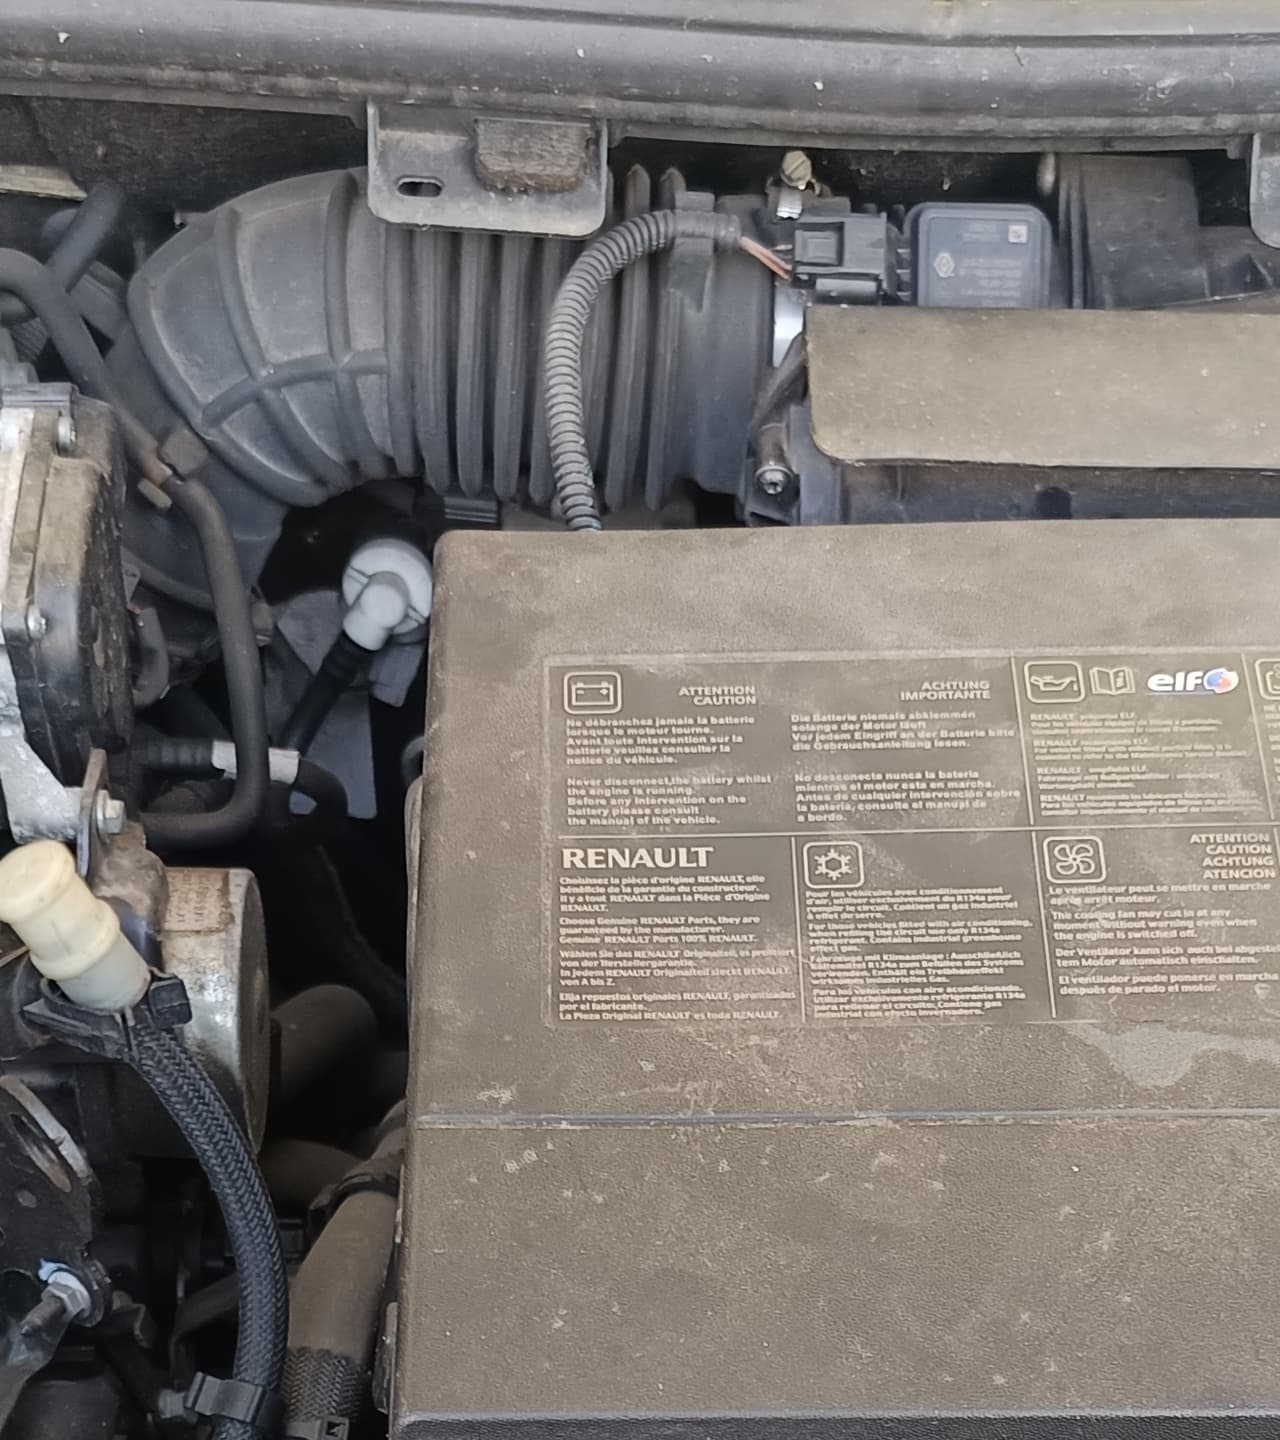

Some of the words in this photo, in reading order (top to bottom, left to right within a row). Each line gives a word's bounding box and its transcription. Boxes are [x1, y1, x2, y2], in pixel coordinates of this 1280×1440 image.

[921, 680, 990, 690] ACHTUNG
[1147, 671, 1204, 692] elf
[678, 685, 756, 696] ATTENTION
[900, 690, 992, 700] IMPORTANTE
[693, 696, 756, 706] CAUTION
[584, 718, 653, 726] débranchez
[655, 717, 695, 727] jamais
[710, 716, 755, 724] batterie
[566, 727, 611, 737] lorsque
[626, 726, 669, 735] moteur
[671, 726, 715, 734] tourne.
[792, 722, 838, 732] solange
[840, 722, 860, 730] der
[862, 722, 897, 730] Motor
[566, 737, 601, 745] Avant
[603, 737, 634, 745] toute
[636, 736, 707, 744] intervention
[792, 733, 813, 741] Vor
[815, 732, 851, 742] jedem
[853, 731, 897, 741] Eingriff
[917, 730, 938, 738] der
[939, 729, 986, 738] Batterie
[987, 729, 1014, 737] bitte
[792, 742, 811, 750] die
[813, 741, 932, 750] Gebrauchsanleitung
[933, 739, 969, 747] lesen.
[566, 747, 611, 755] batterie
[613, 746, 659, 754] veuillez
[661, 745, 717, 753] consulter
[566, 756, 603, 764] notice
[623, 755, 677, 763] véhicule.
[567, 777, 602, 785] Never
[672, 776, 690, 784] the
[691, 776, 733, 786] battery
[735, 775, 771, 784] whilst
[567, 787, 586, 795] the
[588, 786, 630, 796] engine
[568, 797, 607, 805] Before
[634, 796, 706, 804] intervention
[726, 796, 746, 804] the
[568, 807, 609, 816] battery
[611, 806, 651, 816] please
[653, 806, 699, 814] consult
[568, 817, 587, 825] the
[589, 816, 634, 825] manual
[651, 816, 671, 824] the
[672, 816, 720, 824] vehicle.
[1190, 833, 1270, 844] ATTENTION
[1205, 844, 1272, 854] CAUTION
[562, 847, 714, 868] RENAULT
[1202, 856, 1274, 867] ACHTUNG
[1202, 868, 1276, 879] ATENCION
[650, 875, 695, 885] d'origine
[697, 875, 744, 884] RENAULT,
[633, 884, 675, 894] garantie
[692, 884, 760, 892] constructeur.
[1128, 884, 1154, 894] peut
[1170, 883, 1210, 892] mettre
[1228, 882, 1271, 890] marche
[1114, 894, 1159, 903] moteur.
[1052, 911, 1072, 920] The
[1073, 911, 1115, 921] cooling
[1117, 910, 1135, 919] fan
[1137, 912, 1161, 920] may
[1163, 909, 1182, 918] cut
[1210, 911, 1230, 919] any
[560, 917, 595, 925] Choose
[597, 917, 638, 925] Genuine
[640, 916, 685, 924] RENAULT
[687, 916, 716, 926] Parts,
[718, 916, 740, 925] they
[1053, 921, 1099, 929] moment
[1101, 920, 1146, 928] without
[1147, 919, 1194, 929] warning
[1226, 918, 1257, 926] when
[560, 925, 618, 935] guaranteed
[634, 925, 651, 933] the
[1054, 931, 1073, 940] the
[1075, 931, 1114, 941] engine
[1127, 930, 1177, 938] switched
[1179, 929, 1198, 938] off.
